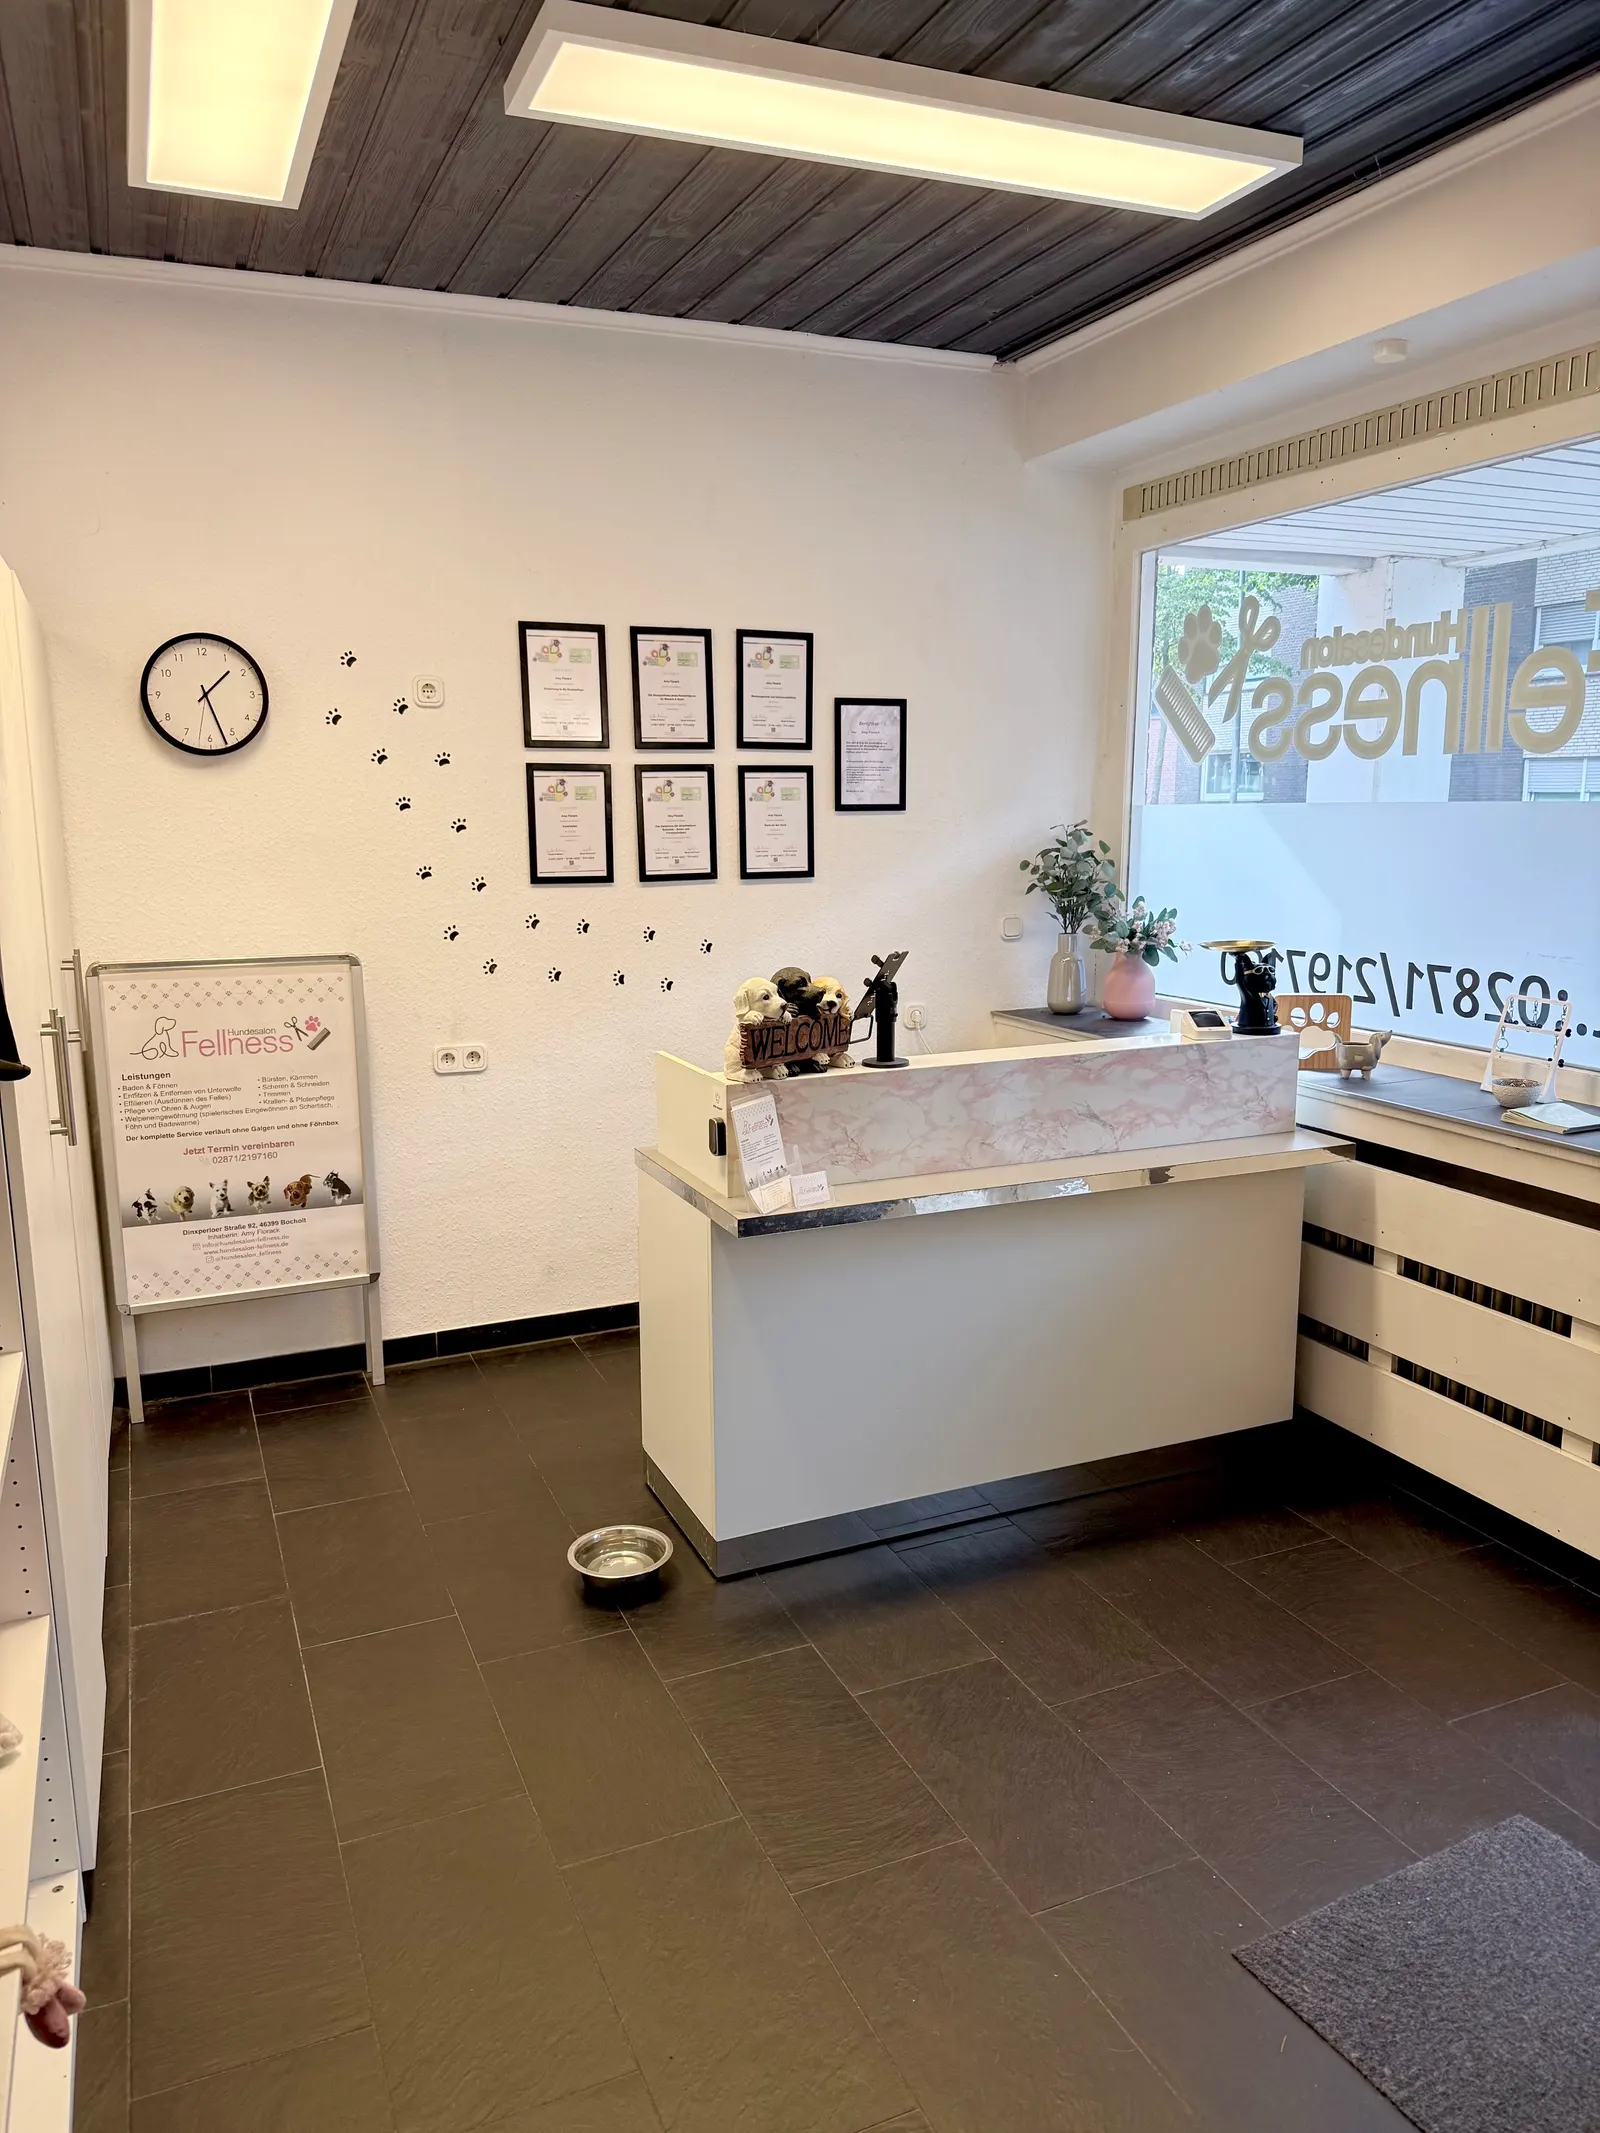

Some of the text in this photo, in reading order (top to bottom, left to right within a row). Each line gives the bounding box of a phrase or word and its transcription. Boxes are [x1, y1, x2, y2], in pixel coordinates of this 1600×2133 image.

[196, 647, 208, 656] 12
[174, 653, 184, 662] 11
[223, 654, 227, 662] 1
[160, 669, 172, 678] 10
[240, 669, 246, 677] 2
[155, 690, 161, 699] 9
[249, 690, 256, 699] 3
[165, 712, 171, 721] 8
[184, 727, 189, 736] 7
[229, 728, 235, 736] 5
[227, 1027, 277, 1036] Hundesalon
[750, 1016, 849, 1061] WELCOME
[181, 1029, 294, 1058] Fellness
[121, 1071, 171, 1081] Leistungen
[152, 1082, 178, 1090] Föhnen
[207, 1086, 242, 1094] Unterwolle
[263, 1090, 291, 1098] Trimmen
[190, 1103, 212, 1111] Augen
[140, 1132, 175, 1141] komplette
[176, 1130, 203, 1138] Service
[204, 1128, 231, 1136] verläuft
[182, 1139, 295, 1156] Jetzt Termin vereinbaren
[212, 1151, 278, 1165] 02871/2197160
[224, 1223, 247, 1231] Straße
[259, 1220, 279, 1228] 46399
[280, 1217, 307, 1226] Bocholt
